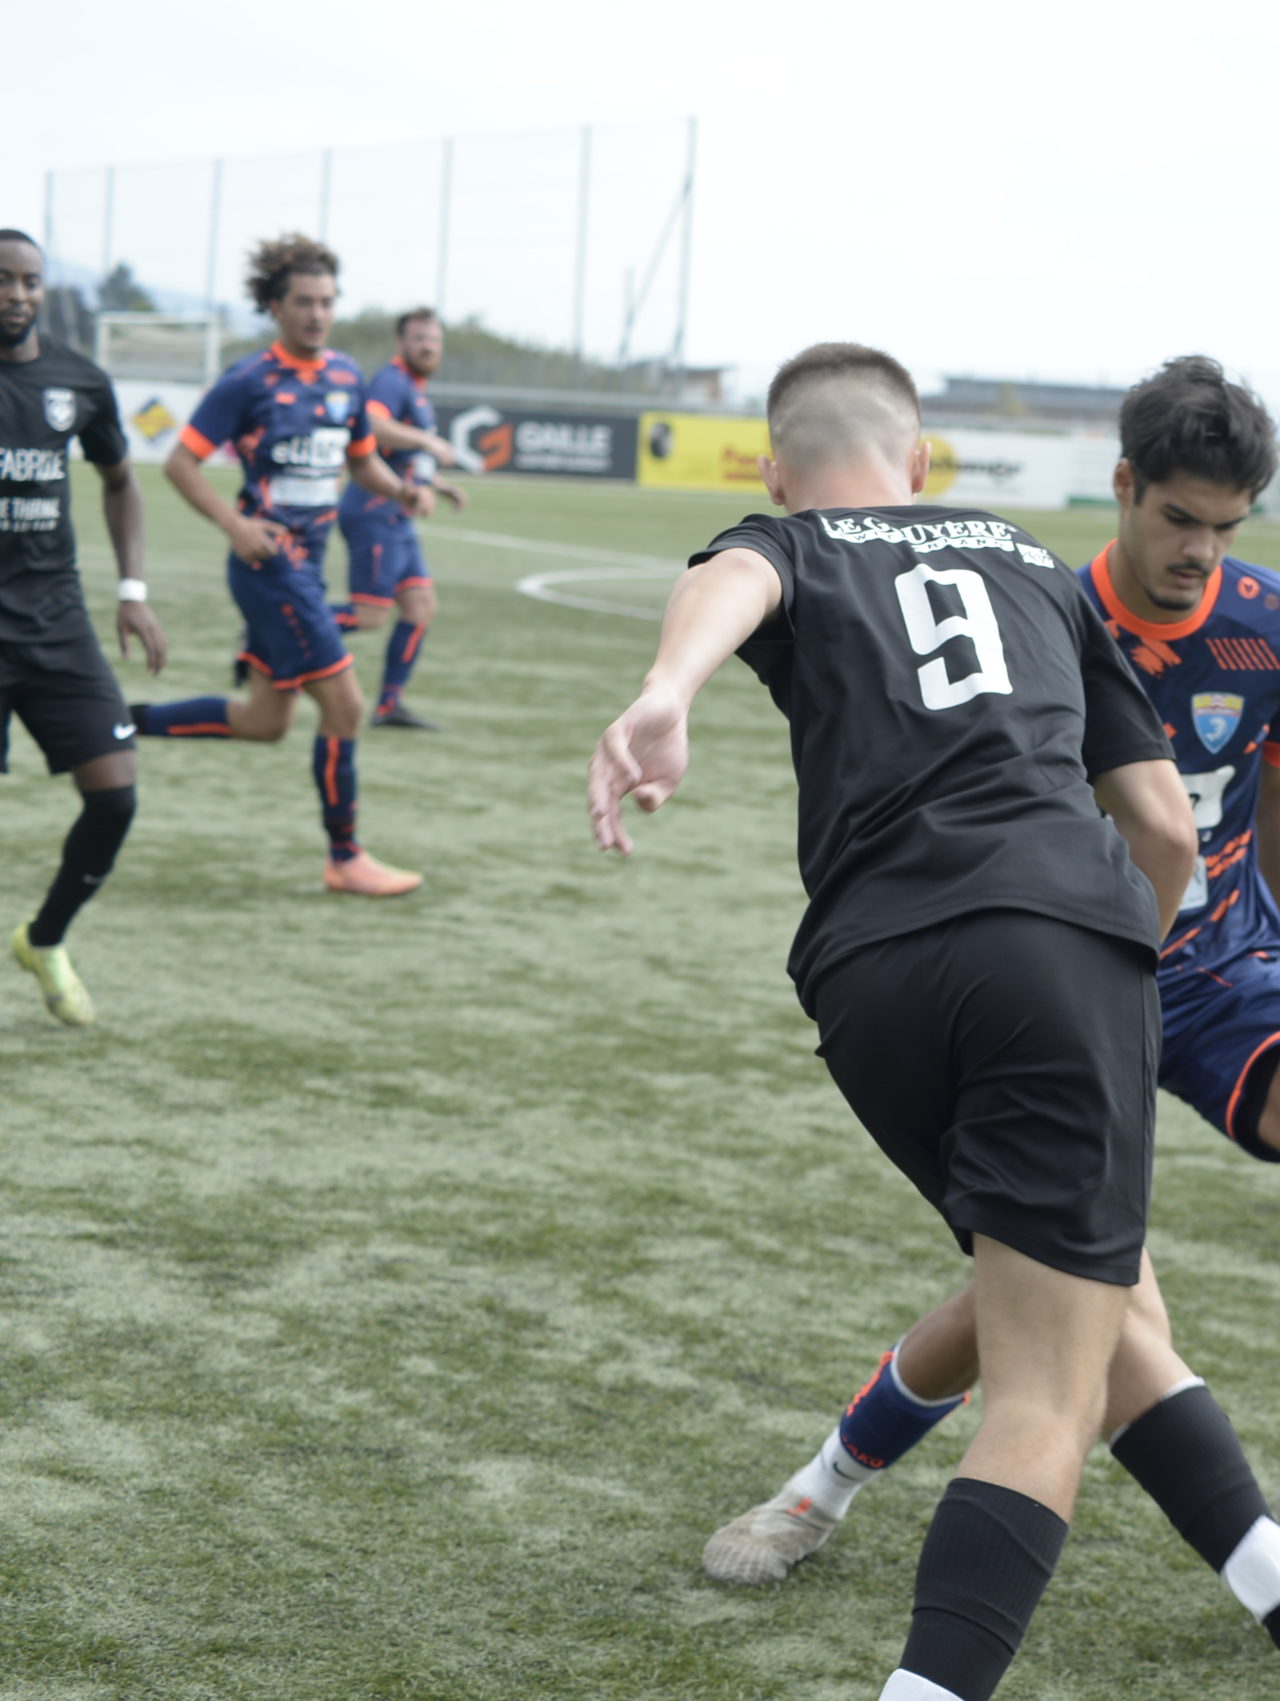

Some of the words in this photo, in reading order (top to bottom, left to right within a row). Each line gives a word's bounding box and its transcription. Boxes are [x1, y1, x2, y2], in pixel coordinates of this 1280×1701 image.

[820, 515, 862, 535] LE
[862, 517, 1012, 545] GUYÈRE
[894, 563, 1014, 711] 9
